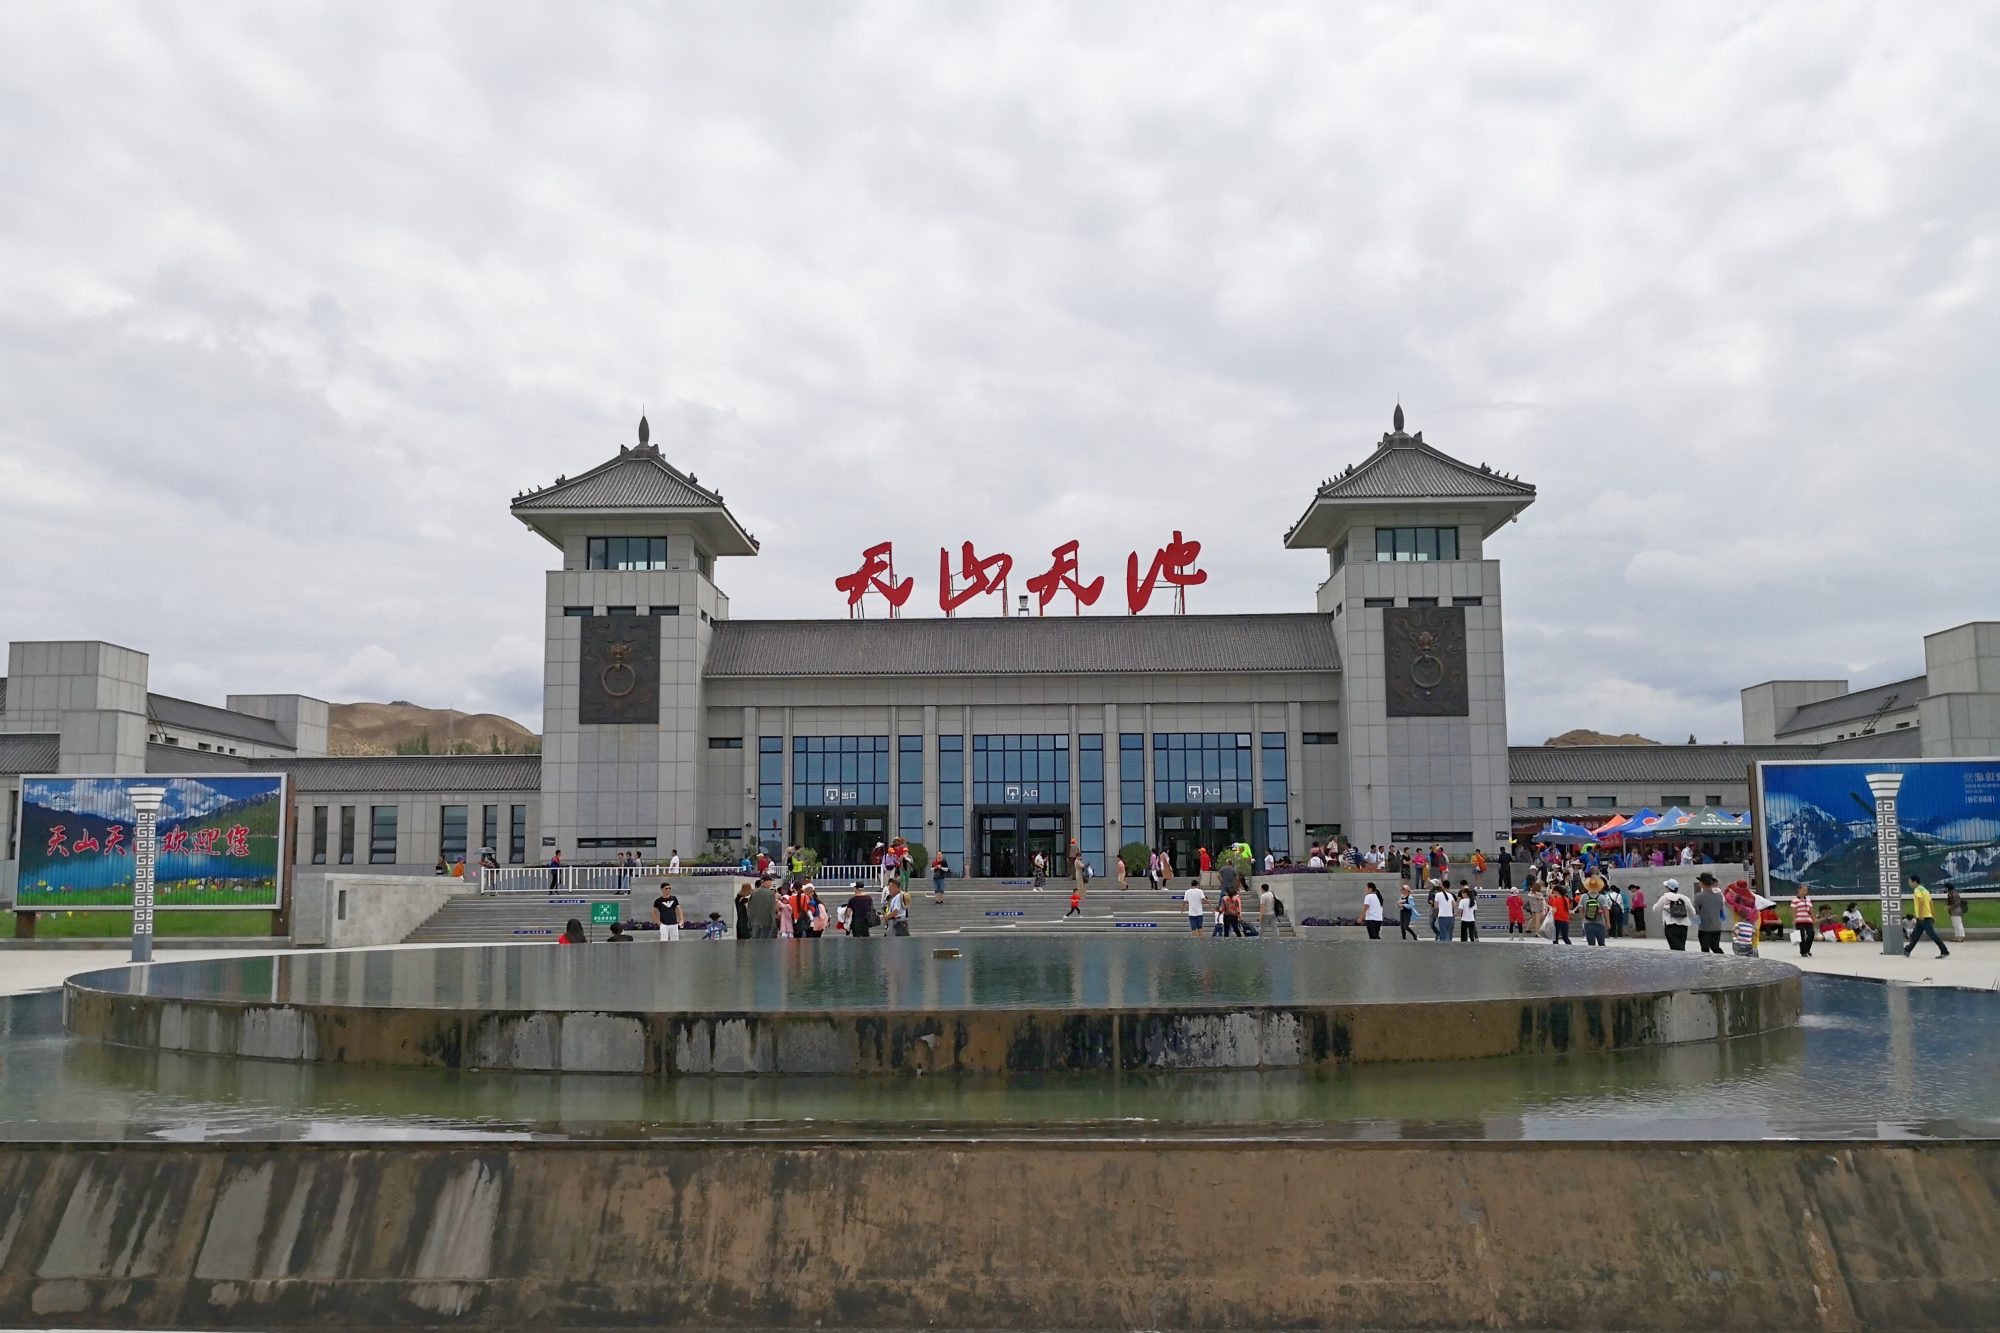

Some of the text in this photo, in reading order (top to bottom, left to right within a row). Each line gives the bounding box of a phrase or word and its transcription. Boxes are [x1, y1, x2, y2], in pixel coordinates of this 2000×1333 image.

[835, 531, 1207, 612] 天山天池
[841, 791, 857, 799] 出口
[1022, 789, 1038, 797] 入口
[1204, 788, 1220, 796] 入口
[47, 824, 252, 856] 天山天欢迎您
